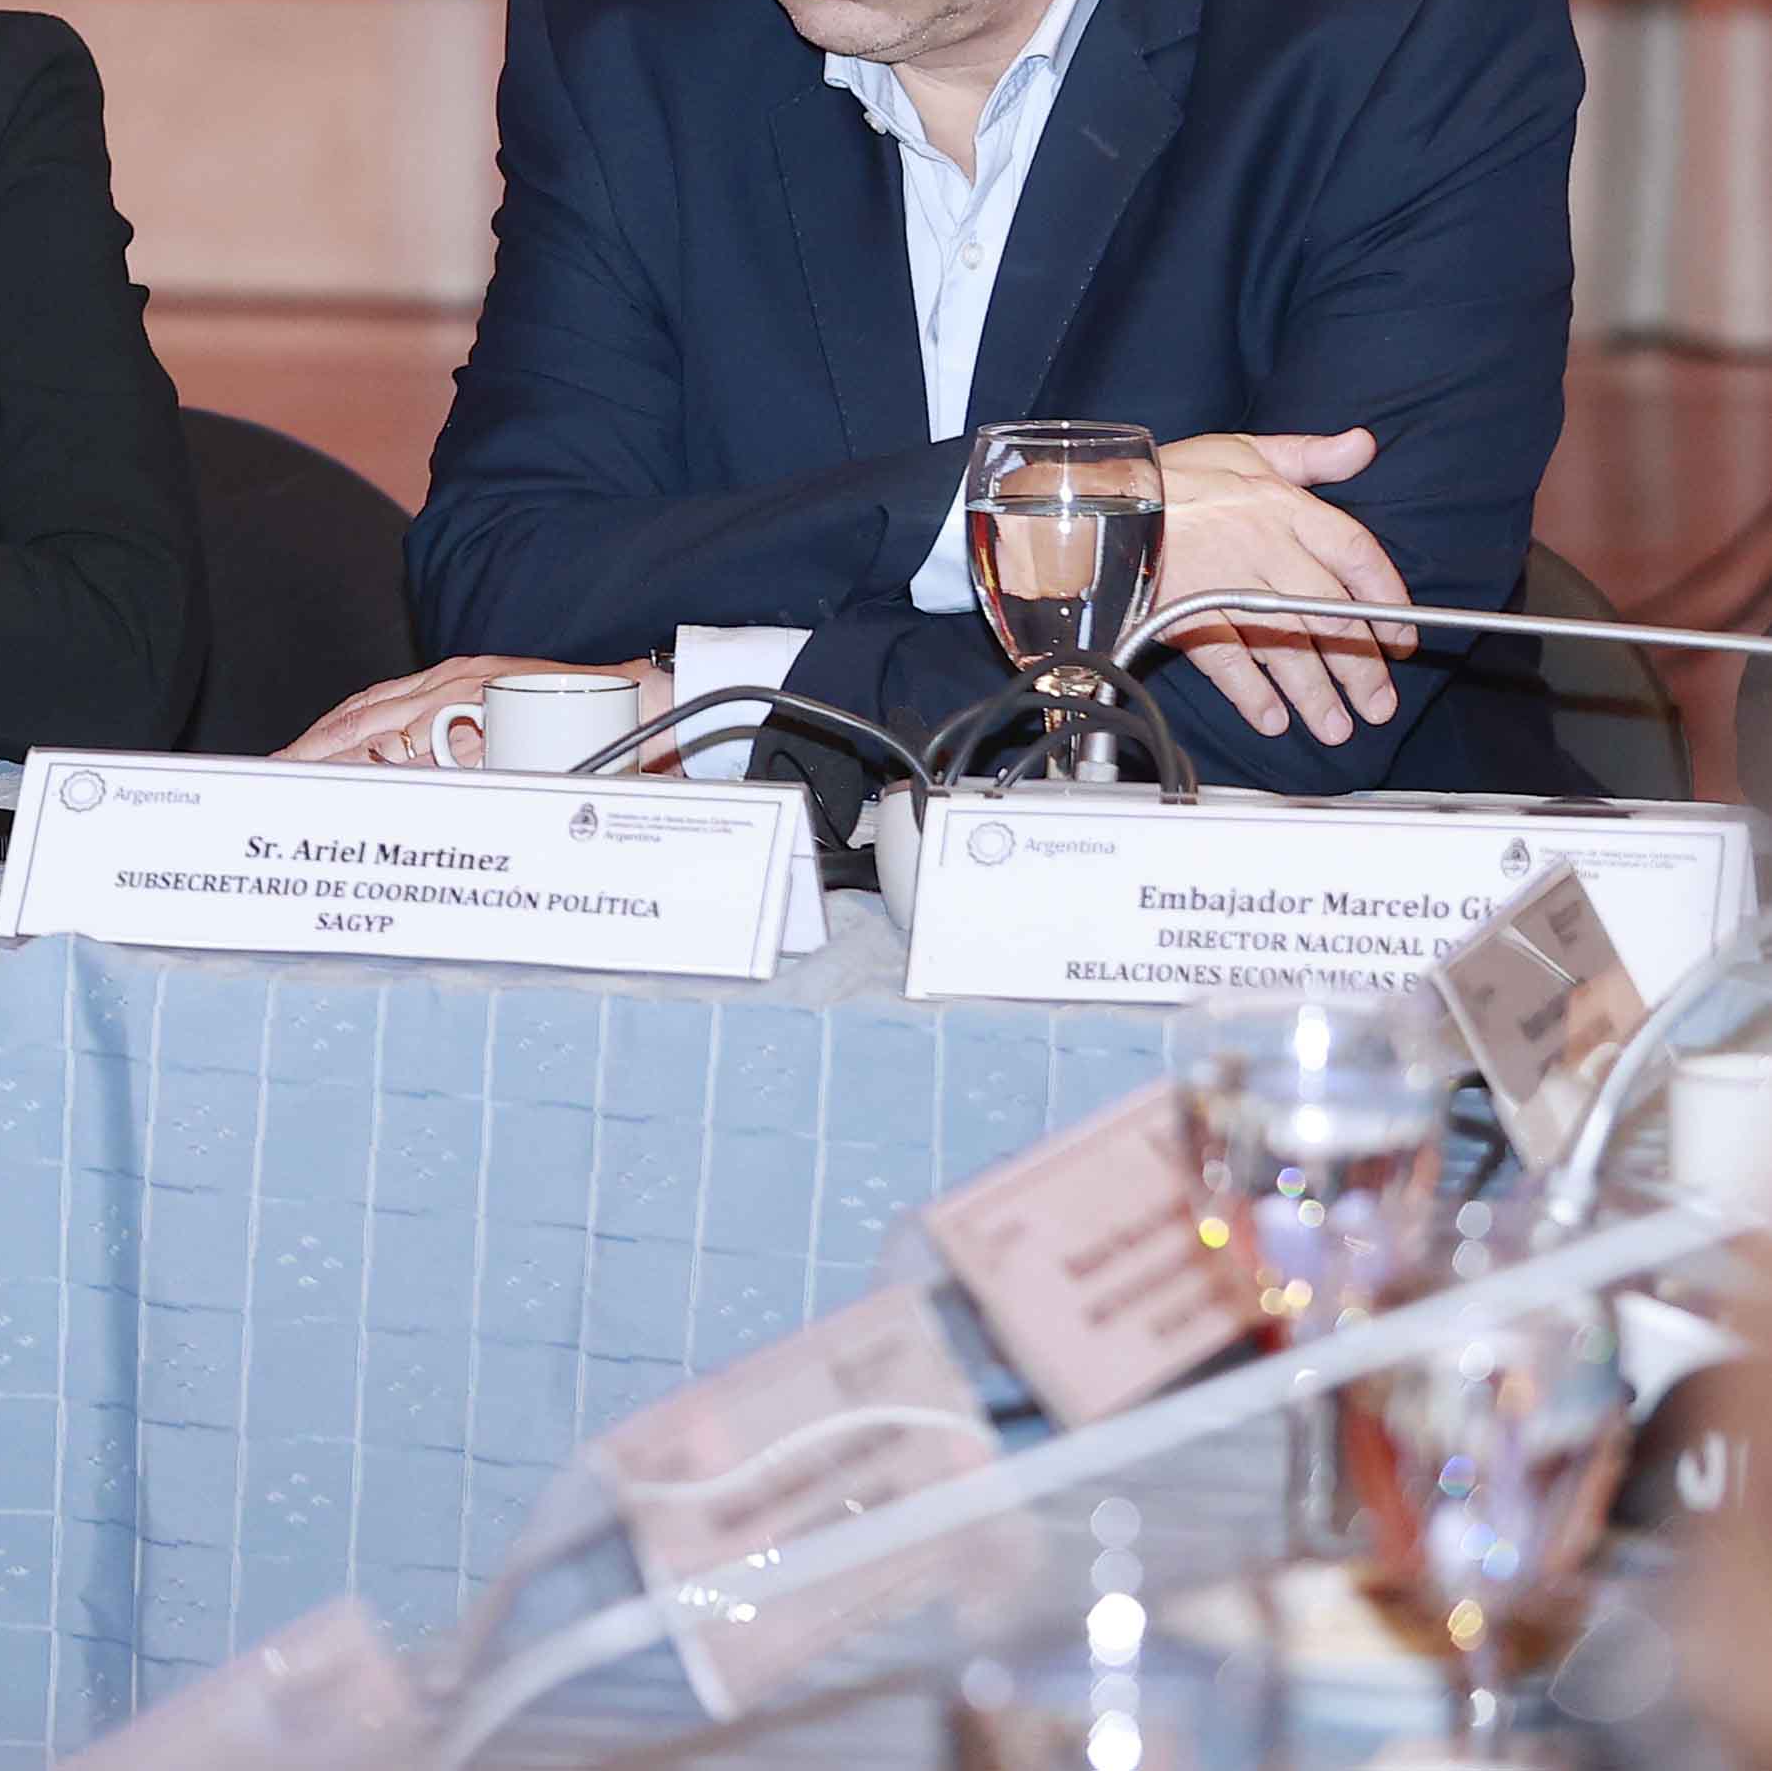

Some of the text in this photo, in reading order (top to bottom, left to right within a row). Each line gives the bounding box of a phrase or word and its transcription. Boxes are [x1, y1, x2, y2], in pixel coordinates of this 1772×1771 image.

[246, 837, 509, 871] Sr. Ariel Martinez
[115, 871, 659, 918] SUBSECRETARIO DE COORDINACIÓN POLÍTICA
[1139, 886, 1313, 916] Embajador
[1323, 892, 1449, 918] Marcelo
[316, 913, 393, 932] SAGYP
[1158, 930, 1287, 951] DIRECTOR
[1296, 934, 1424, 956] NACIONAL
[1066, 962, 1222, 986] RELACIONES
